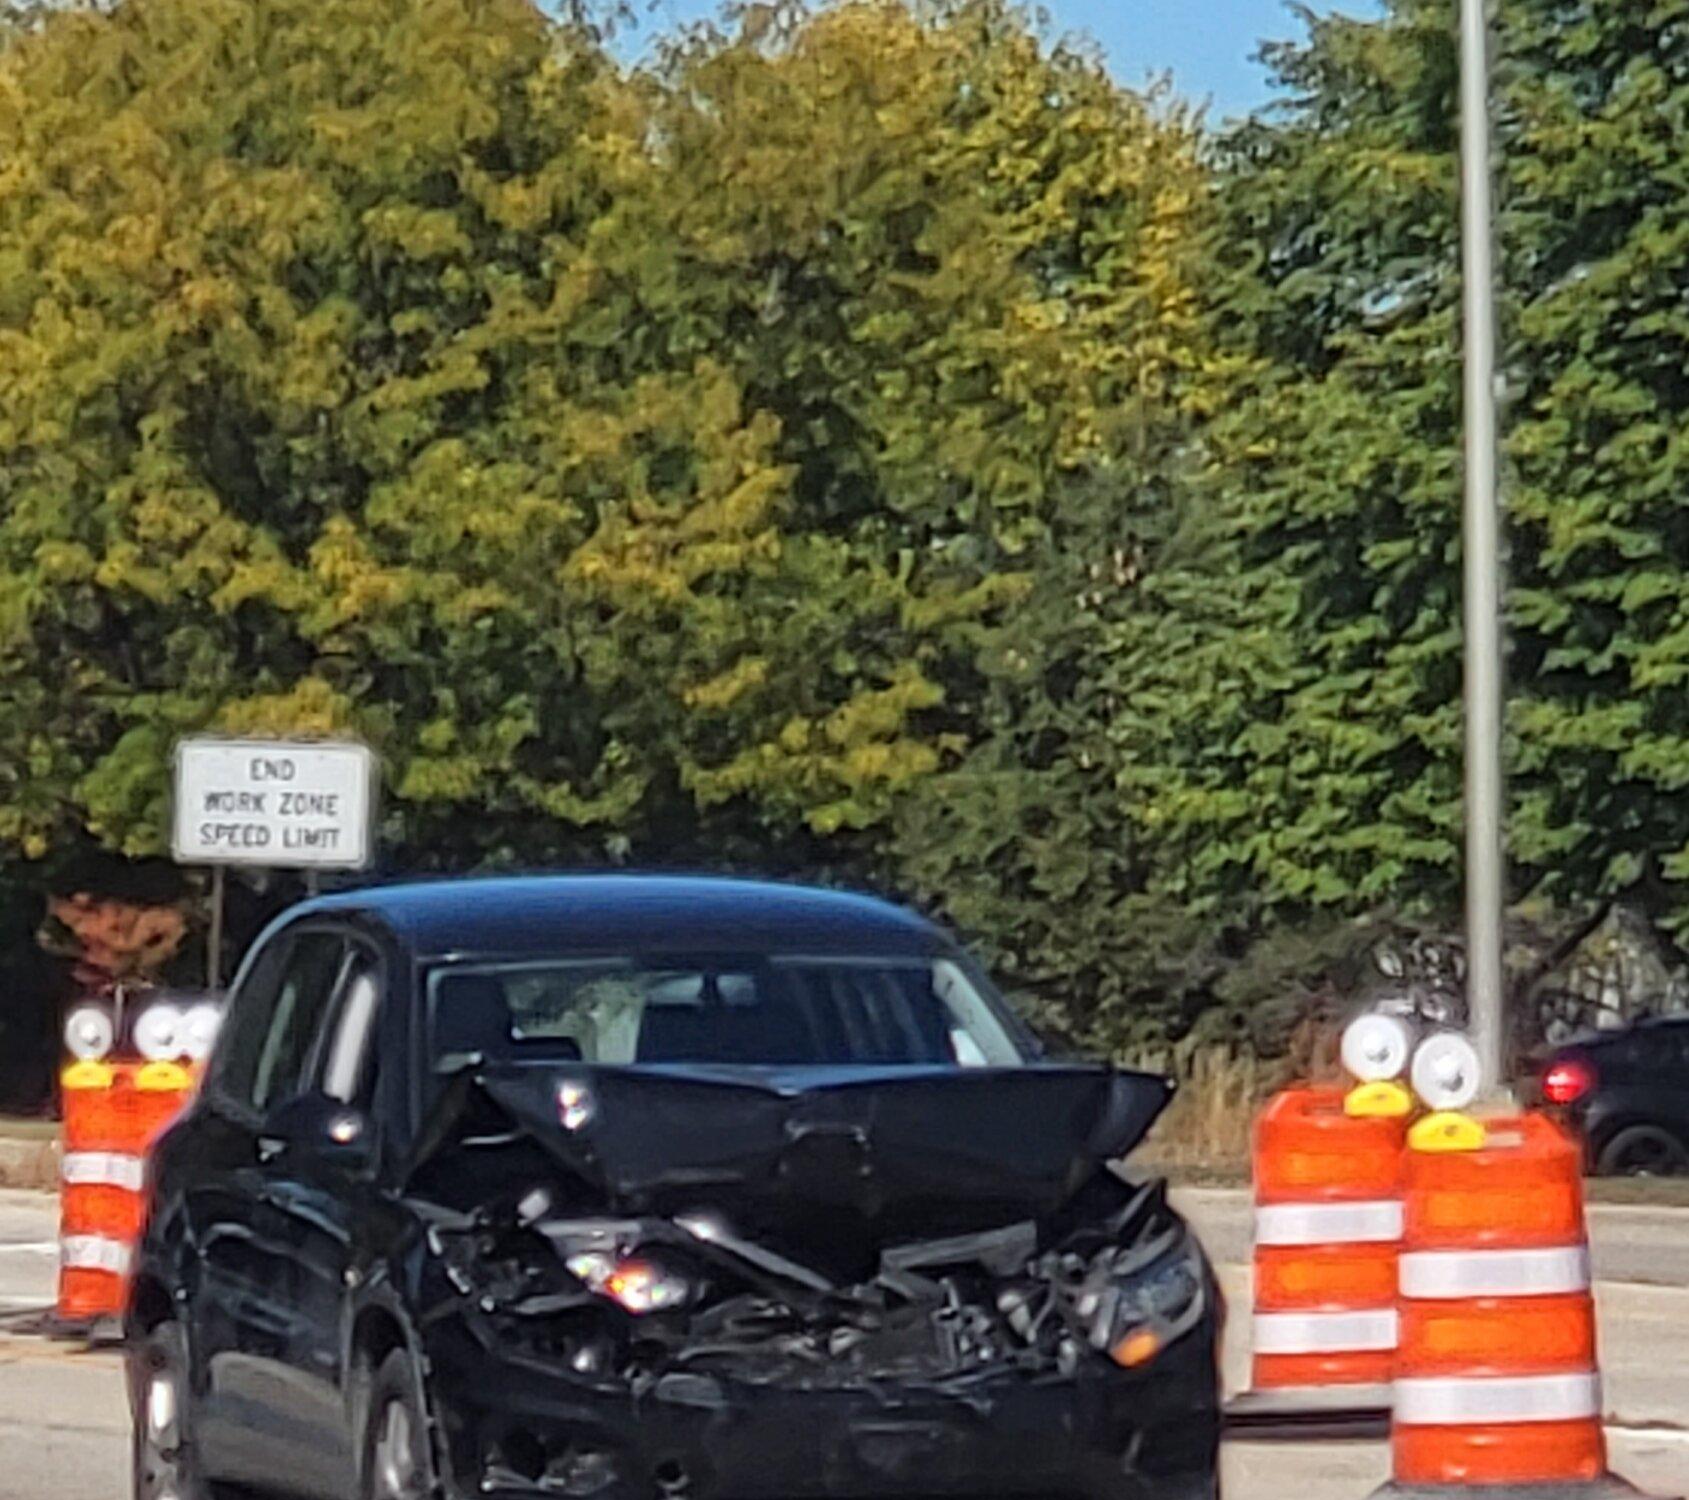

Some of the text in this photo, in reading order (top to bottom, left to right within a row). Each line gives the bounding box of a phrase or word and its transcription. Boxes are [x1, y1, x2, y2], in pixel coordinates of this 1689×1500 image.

[250, 758, 296, 781] END
[204, 792, 339, 816] WORK ZONE
[200, 823, 340, 848] SPEED LIMIT
